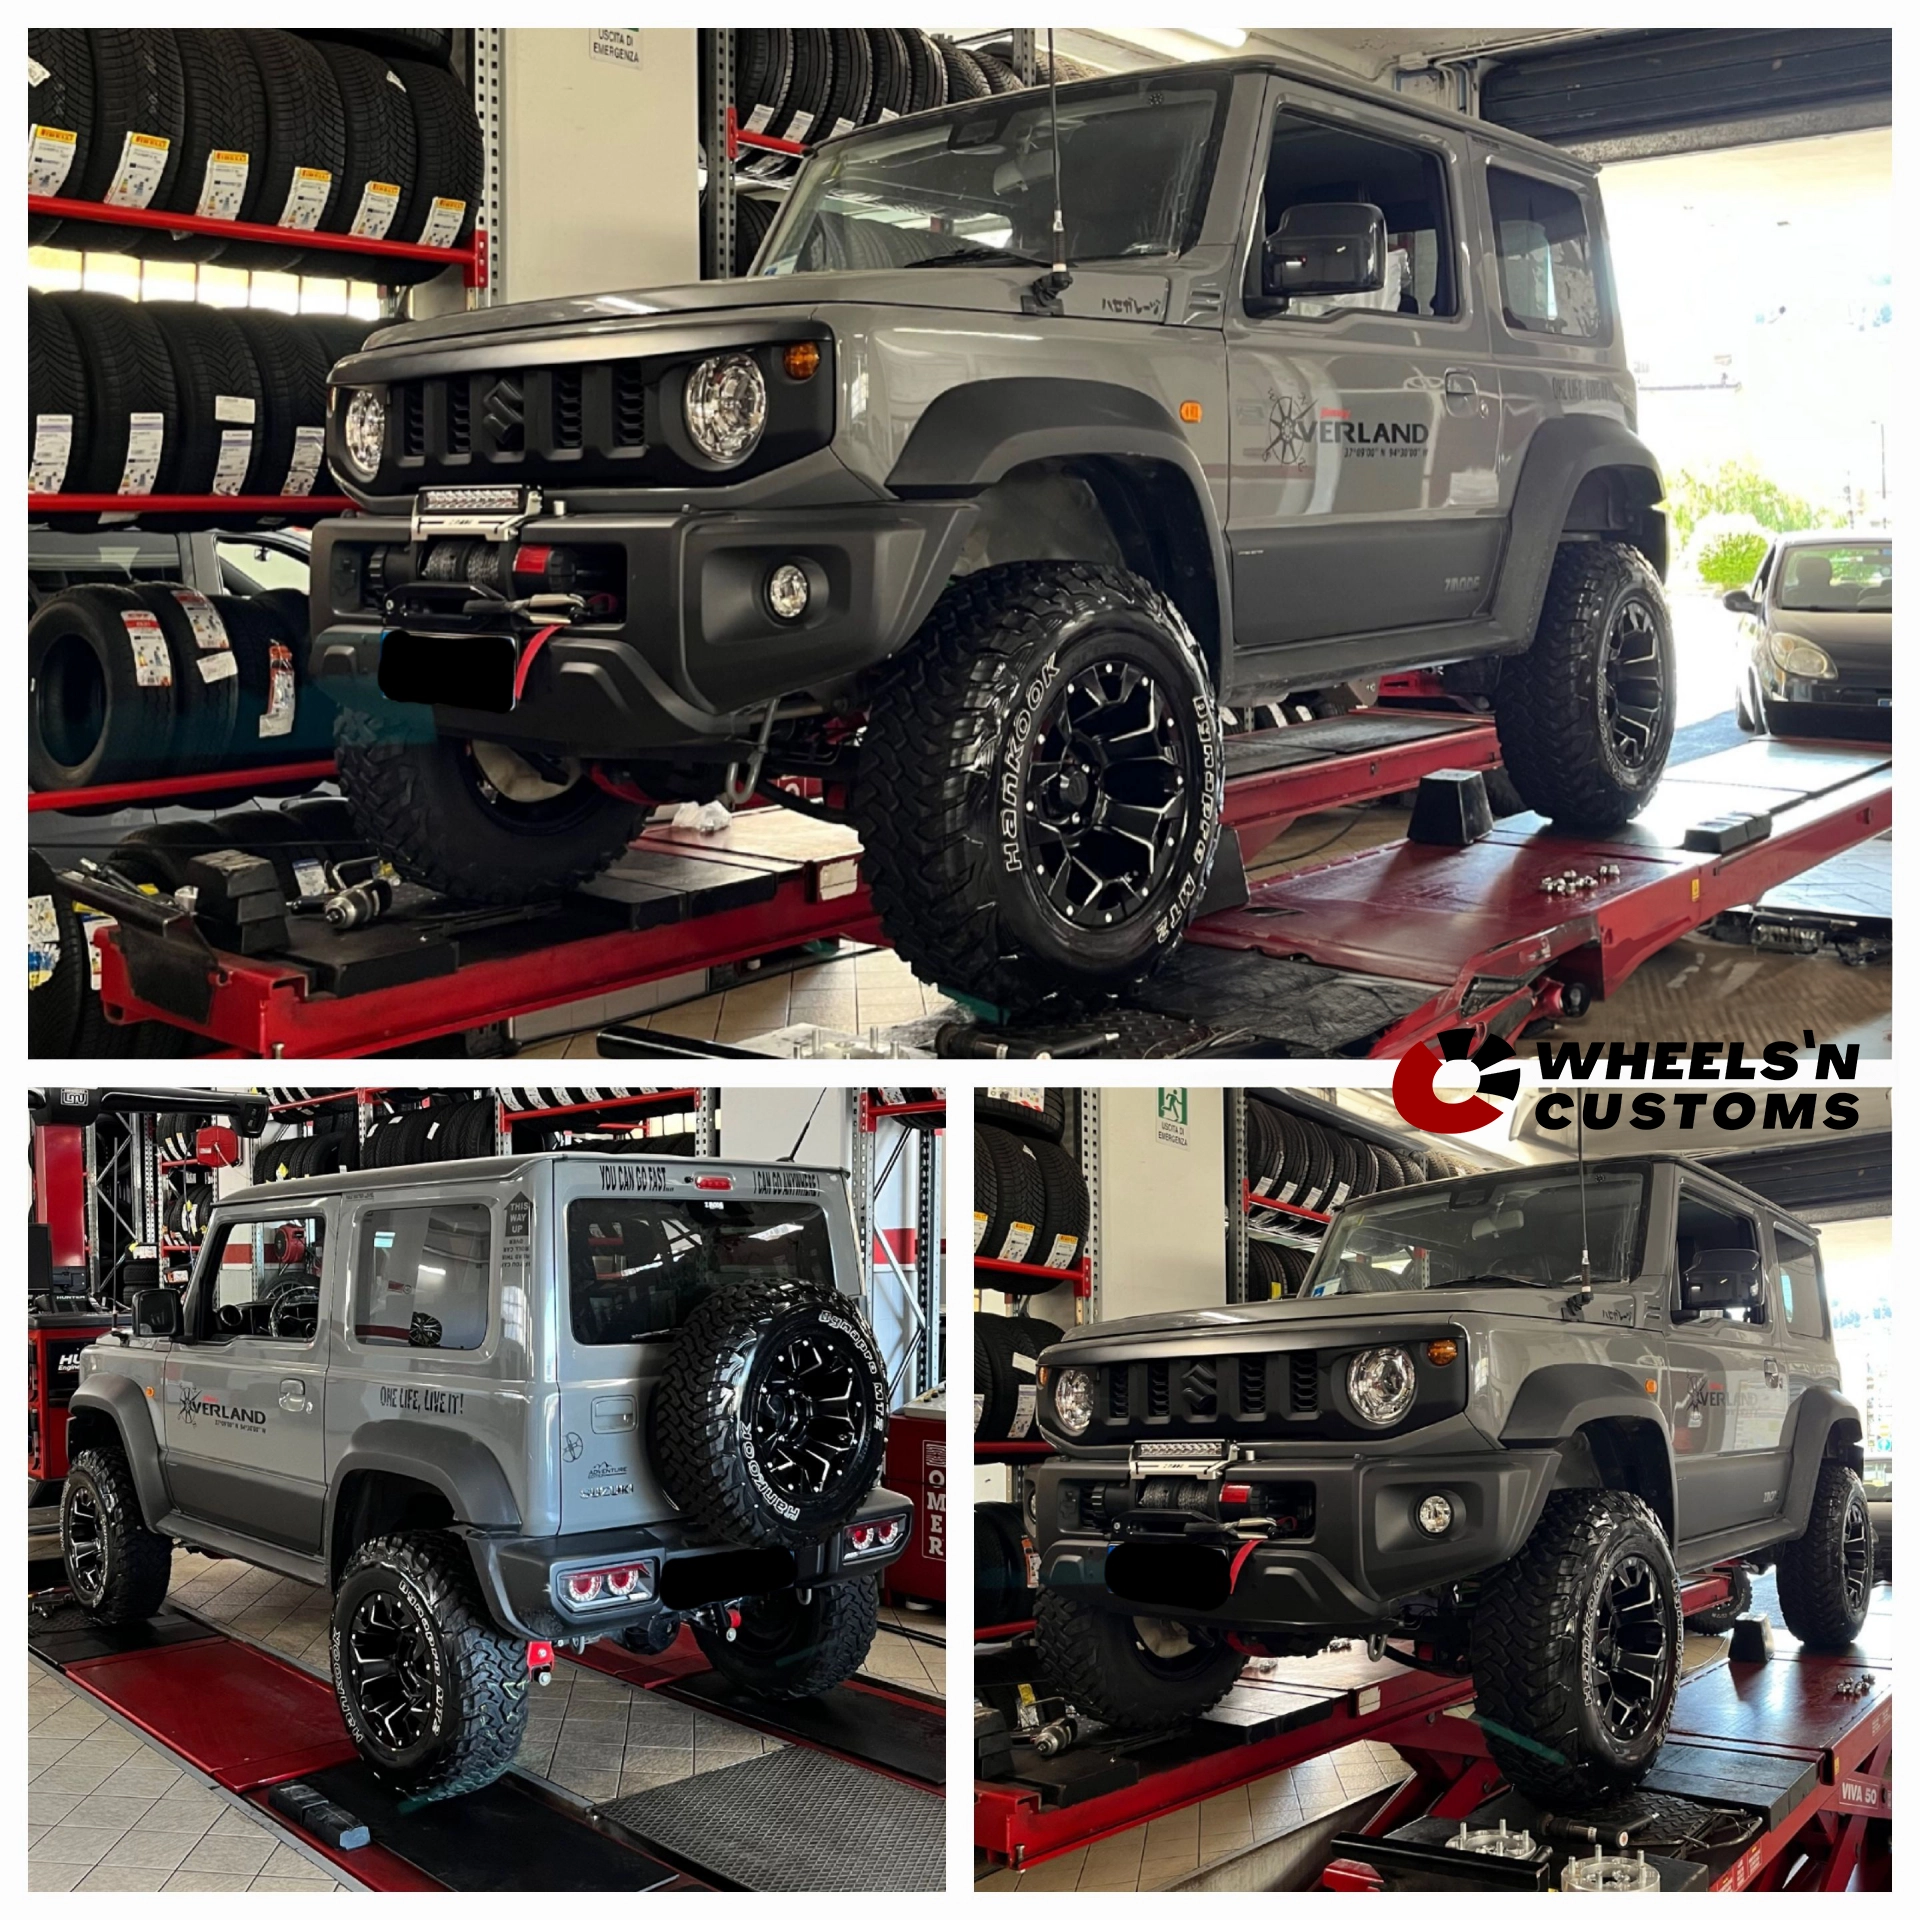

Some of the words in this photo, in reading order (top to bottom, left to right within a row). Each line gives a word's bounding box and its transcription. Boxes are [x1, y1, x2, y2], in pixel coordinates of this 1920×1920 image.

[598, 28, 624, 44] USCITA
[626, 34, 634, 46] DI
[593, 42, 639, 62] EMERGENZA
[1158, 1131, 1187, 1146] EMERGENZA
[599, 1165, 617, 1191] YOU
[618, 1165, 635, 1191] CAN
[636, 1166, 647, 1191] GO
[757, 1171, 771, 1195] CAN
[772, 1171, 782, 1195] GO
[510, 1202, 529, 1211] THIS
[510, 1213, 527, 1223] WAY
[511, 1225, 523, 1233] UP
[380, 1386, 398, 1408] ONE
[399, 1387, 420, 1413] LIFE,
[424, 1389, 446, 1413] LIVE
[590, 1466, 628, 1474] ADVENTURE
[579, 1483, 634, 1500] SUZUKI
[1841, 1782, 1863, 1803] VIVA
[1864, 1786, 1878, 1805] 50
